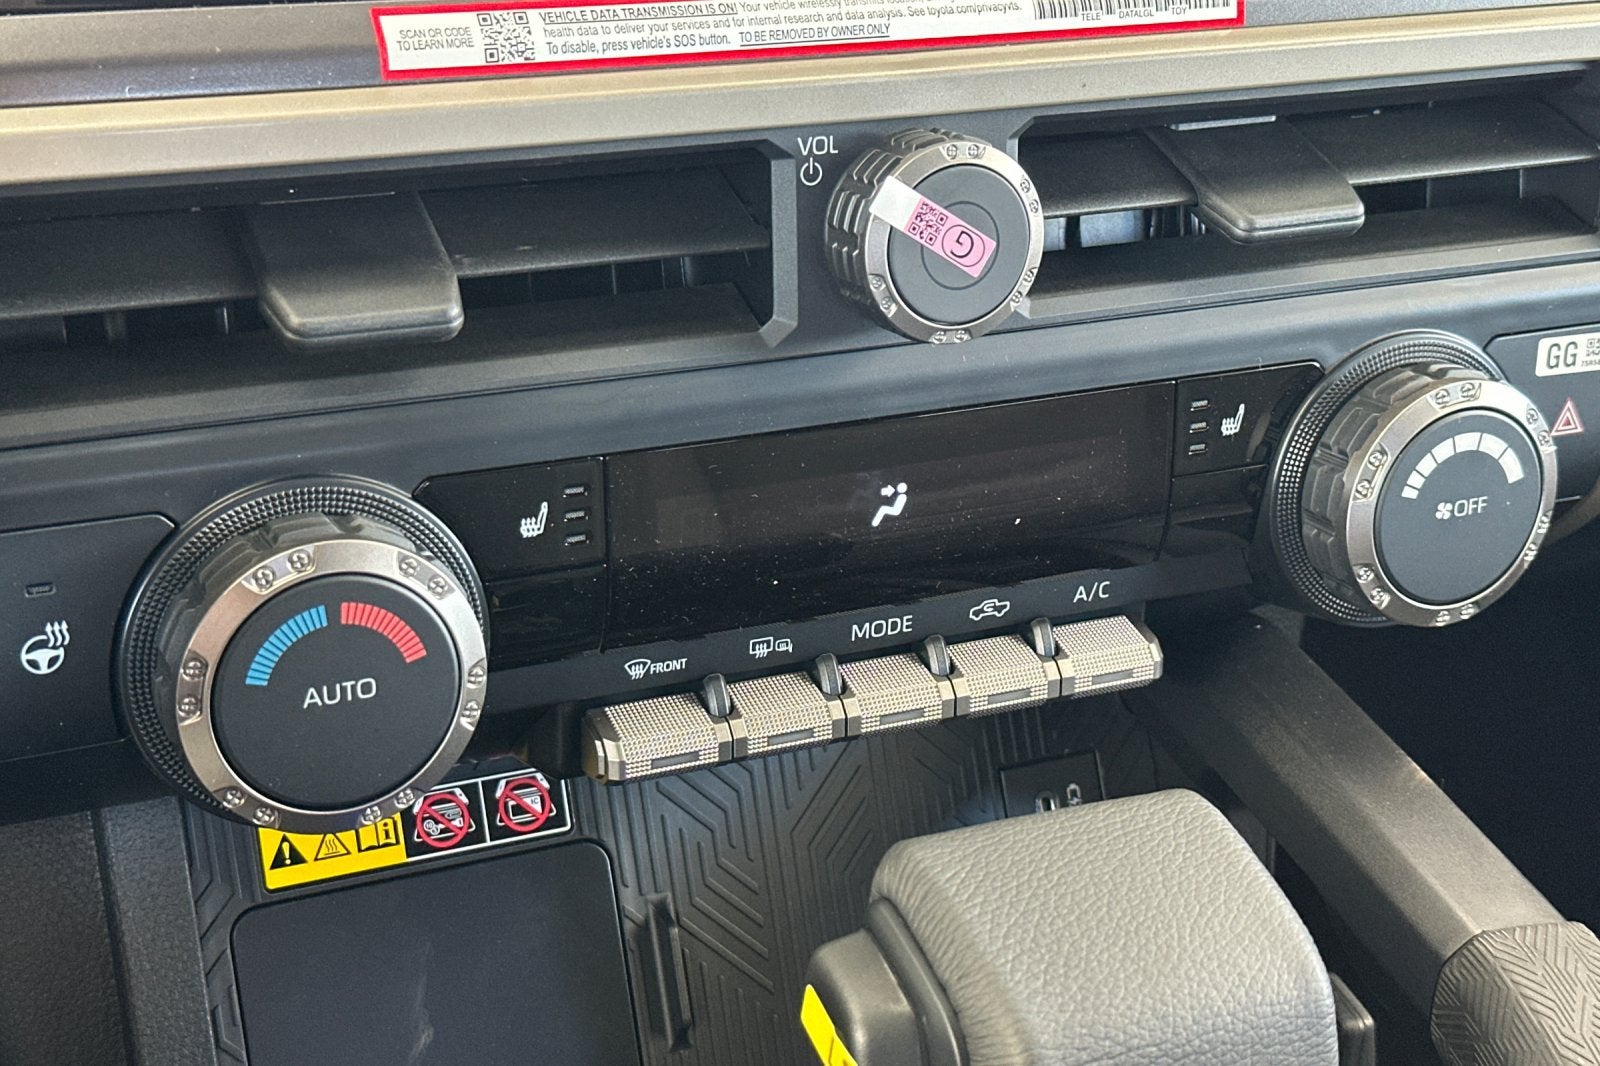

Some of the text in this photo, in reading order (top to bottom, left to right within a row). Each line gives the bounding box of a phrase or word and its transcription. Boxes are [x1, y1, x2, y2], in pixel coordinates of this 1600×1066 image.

[539, 10, 588, 22] VEHICLE
[590, 8, 620, 20] DATA
[620, 5, 703, 19] TRANSMISSION
[706, 4, 716, 14] IS
[740, 1, 761, 12] Your
[764, 0, 796, 10] vehicle
[543, 26, 575, 38] health
[576, 24, 599, 36] data
[601, 25, 611, 35] to
[614, 22, 645, 34] deliver
[647, 22, 669, 35] your
[672, 19, 711, 31] services
[713, 17, 731, 28] and
[732, 17, 745, 27] for
[747, 14, 782, 26] internal
[784, 12, 824, 24] research
[826, 10, 843, 22] and
[845, 10, 866, 20] data
[867, 7, 906, 20] analysis.
[907, 6, 926, 17] See
[1081, 13, 1101, 22] TELE
[1171, 7, 1187, 16] TOY
[396, 37, 475, 51] TO LEARN MORE
[399, 29, 426, 39] SCAN
[444, 27, 472, 37] CODE
[546, 22, 890, 54] To disable, press vehicle's SOS button. TO BE REMOVED BY OWNER ONLY
[797, 135, 838, 156] VOL
[949, 229, 975, 259] G
[1546, 341, 1578, 370] GG
[1454, 496, 1488, 517] OFF
[1073, 580, 1111, 603] A/C
[851, 615, 913, 642] MODE
[650, 658, 688, 675] FRONT
[303, 677, 377, 709] AUTO
